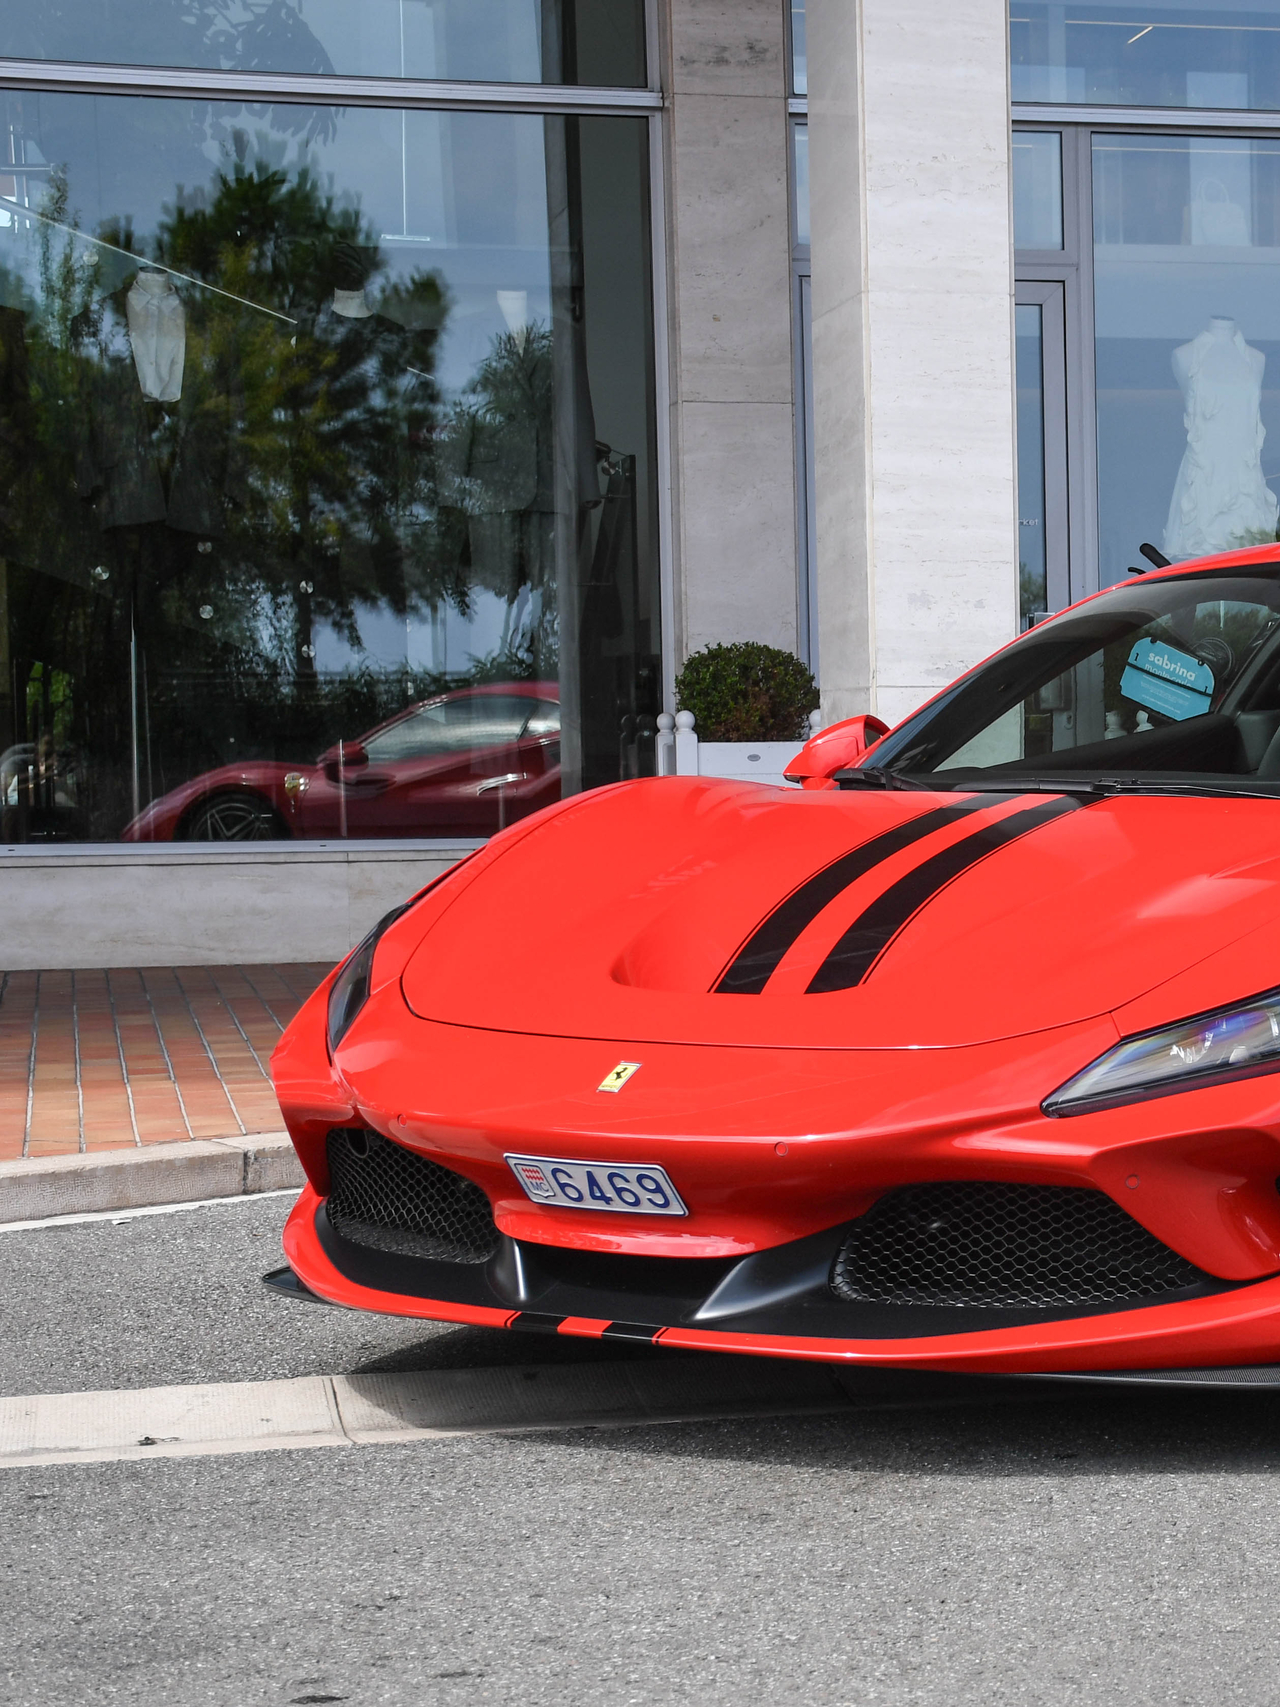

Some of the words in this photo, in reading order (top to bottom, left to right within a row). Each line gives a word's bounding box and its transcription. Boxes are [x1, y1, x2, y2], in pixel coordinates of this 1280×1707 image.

[1148, 652, 1196, 681] sabrina
[530, 1180, 549, 1193] MC
[550, 1167, 671, 1208] 6469
